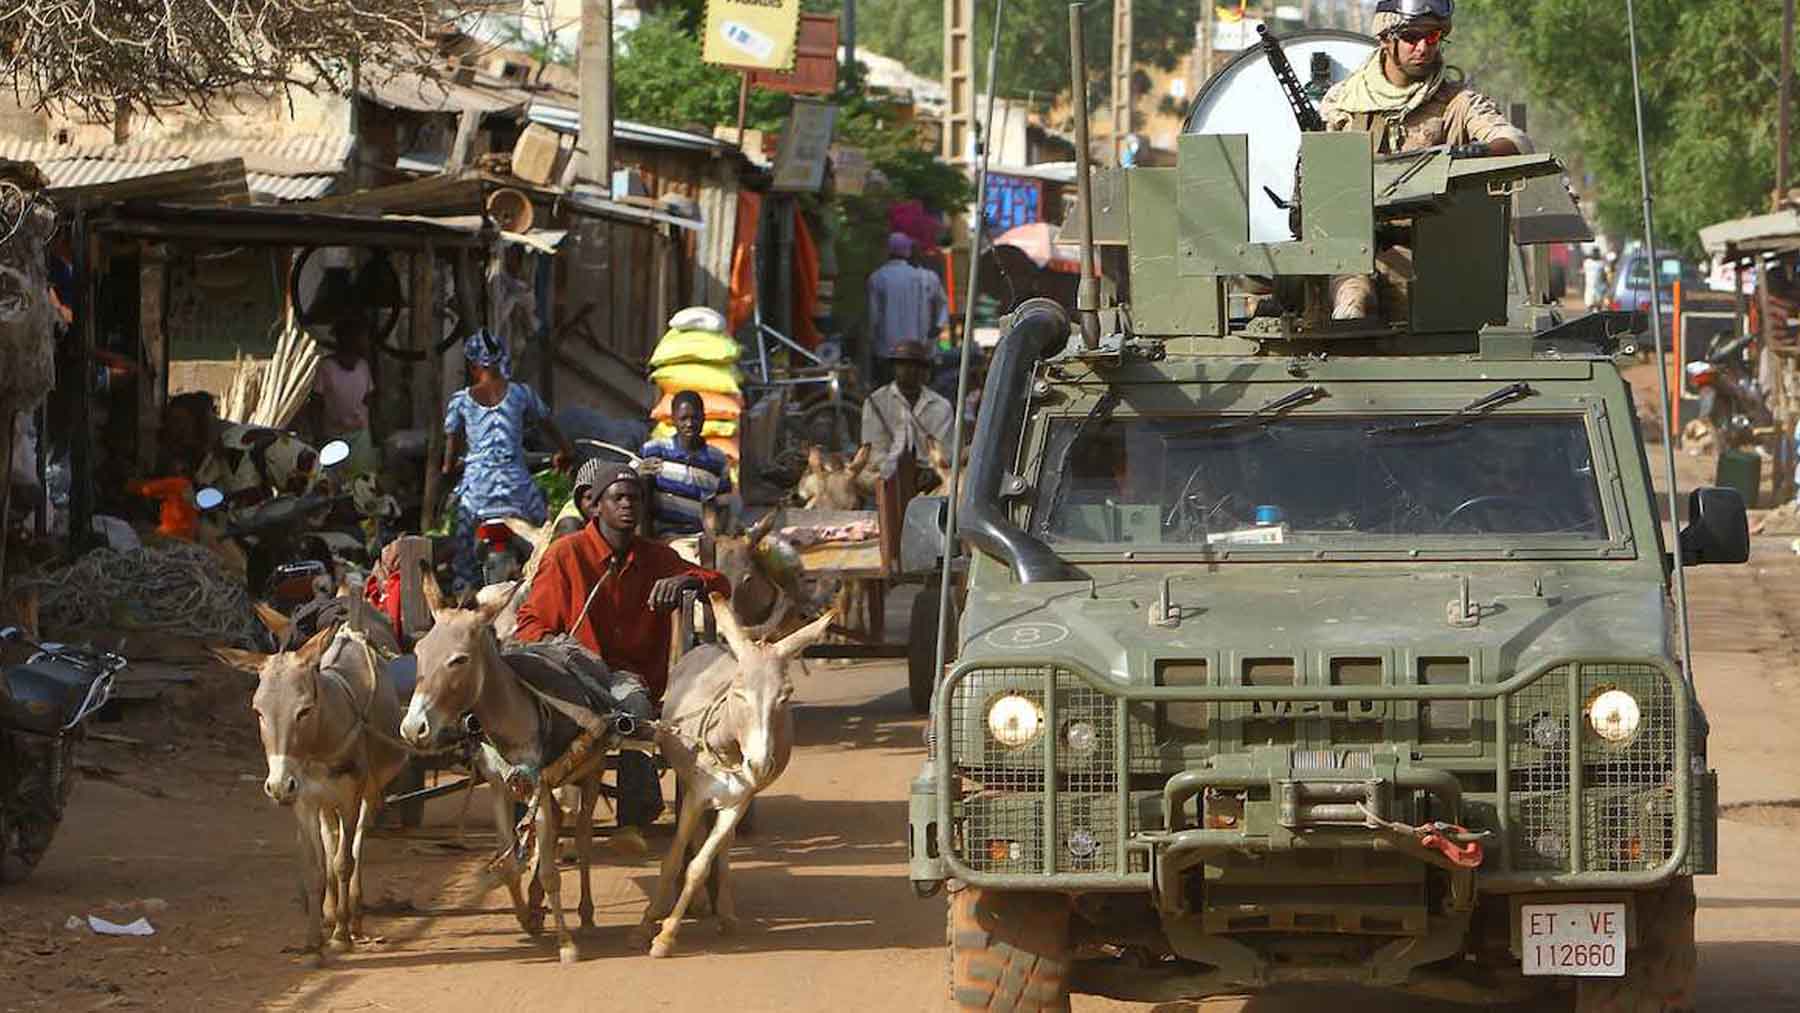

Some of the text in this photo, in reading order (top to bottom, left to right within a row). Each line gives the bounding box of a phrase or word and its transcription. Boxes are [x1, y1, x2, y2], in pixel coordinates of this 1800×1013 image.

[1011, 626, 1041, 642] 8
[1530, 913, 1558, 936] ET
[1590, 911, 1616, 935] VE
[1535, 944, 1616, 967] 112660
